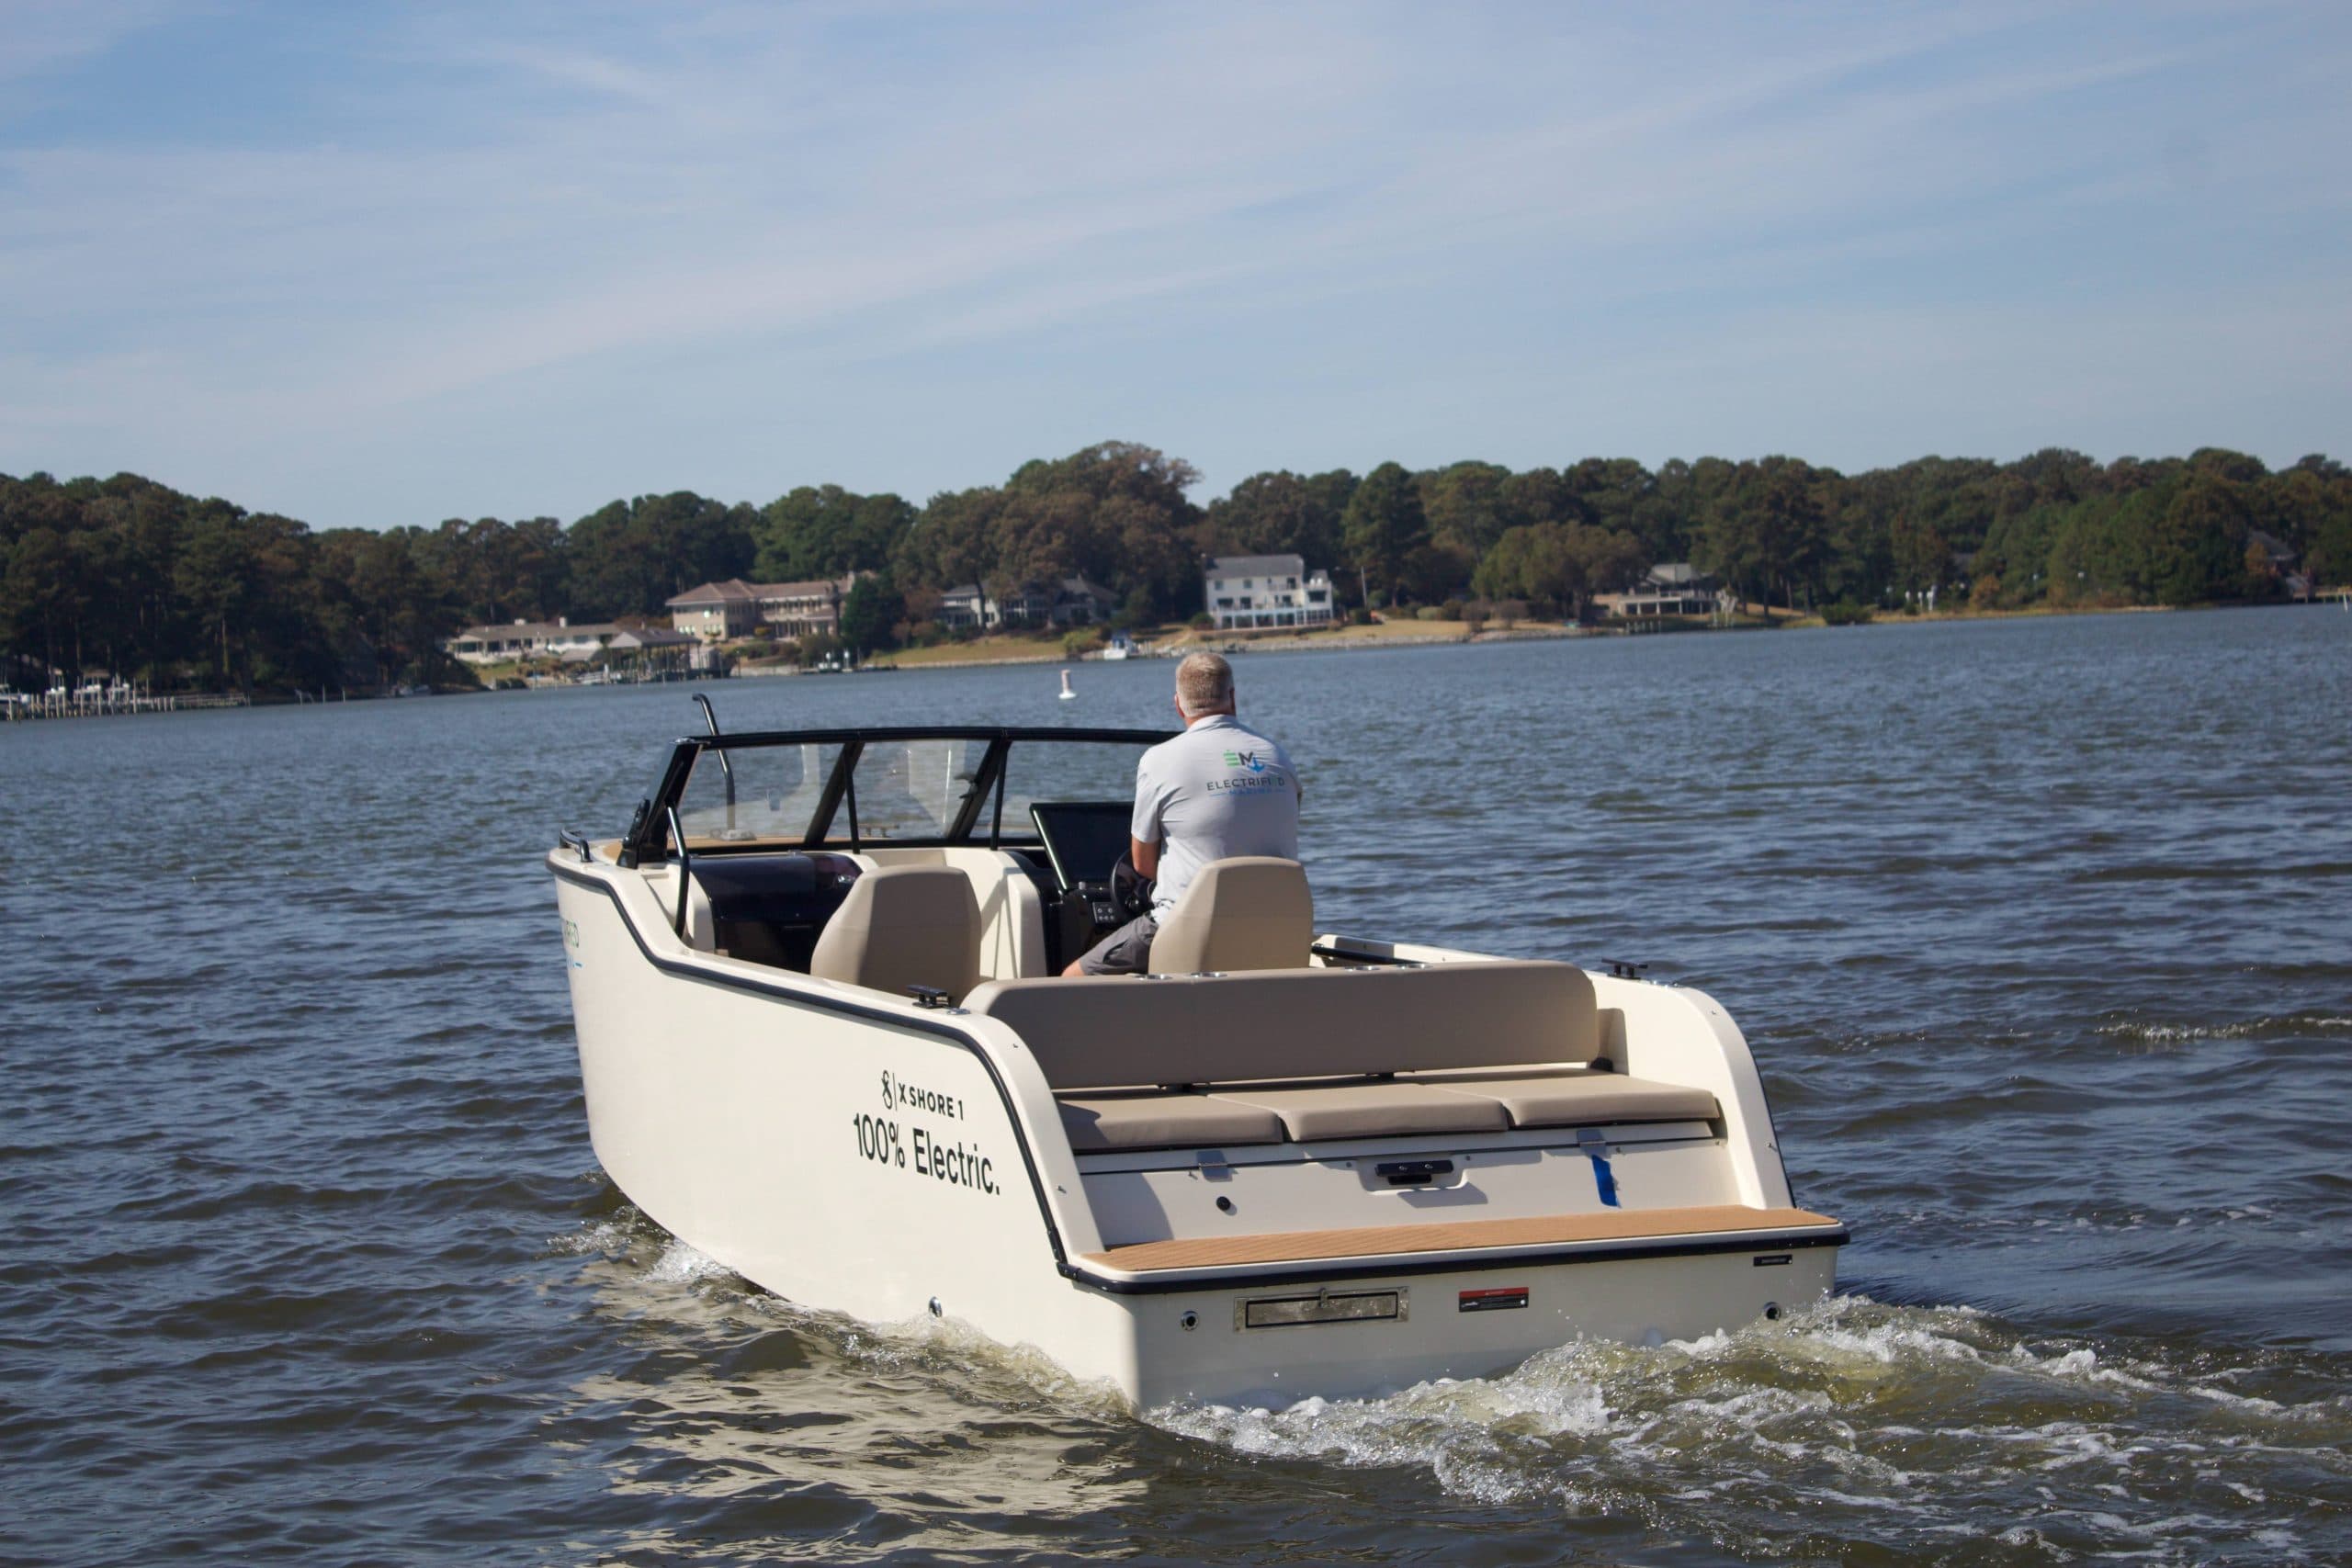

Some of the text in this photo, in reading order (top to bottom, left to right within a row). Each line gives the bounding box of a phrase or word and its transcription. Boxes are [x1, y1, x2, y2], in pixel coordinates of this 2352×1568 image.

[957, 1100, 964, 1121] 1
[853, 1112, 1001, 1195] 100% Electric.
